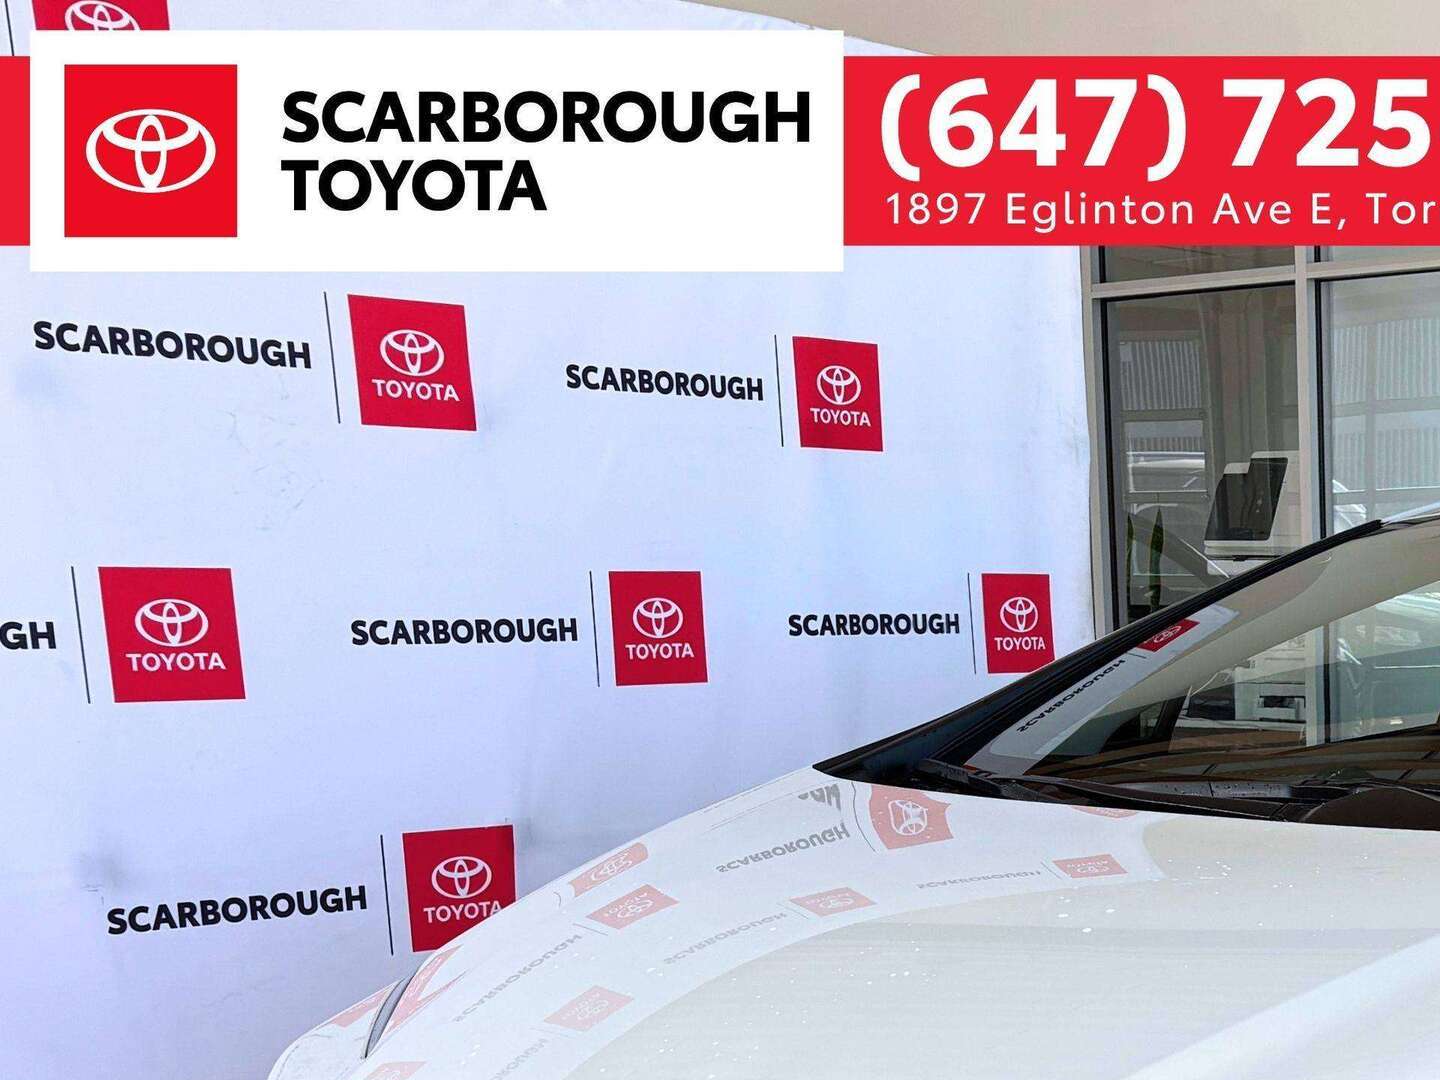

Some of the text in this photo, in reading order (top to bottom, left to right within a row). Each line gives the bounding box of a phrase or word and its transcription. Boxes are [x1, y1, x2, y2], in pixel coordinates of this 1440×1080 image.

[33, 320, 312, 369] SCARBOROUGH
[371, 379, 460, 403] TOYOTA
[566, 364, 764, 401] SCARBOROUGH
[810, 407, 871, 428] TOYOTA
[350, 617, 578, 647] SCARBOROUGH
[788, 613, 960, 637] SCARBOROUGH
[625, 643, 694, 660] TOYOTA
[994, 636, 1046, 651] TOYOTA
[126, 652, 226, 674] TOYOTA
[107, 885, 367, 935] SCARBOROUGH
[423, 900, 502, 923] TOYOTA
